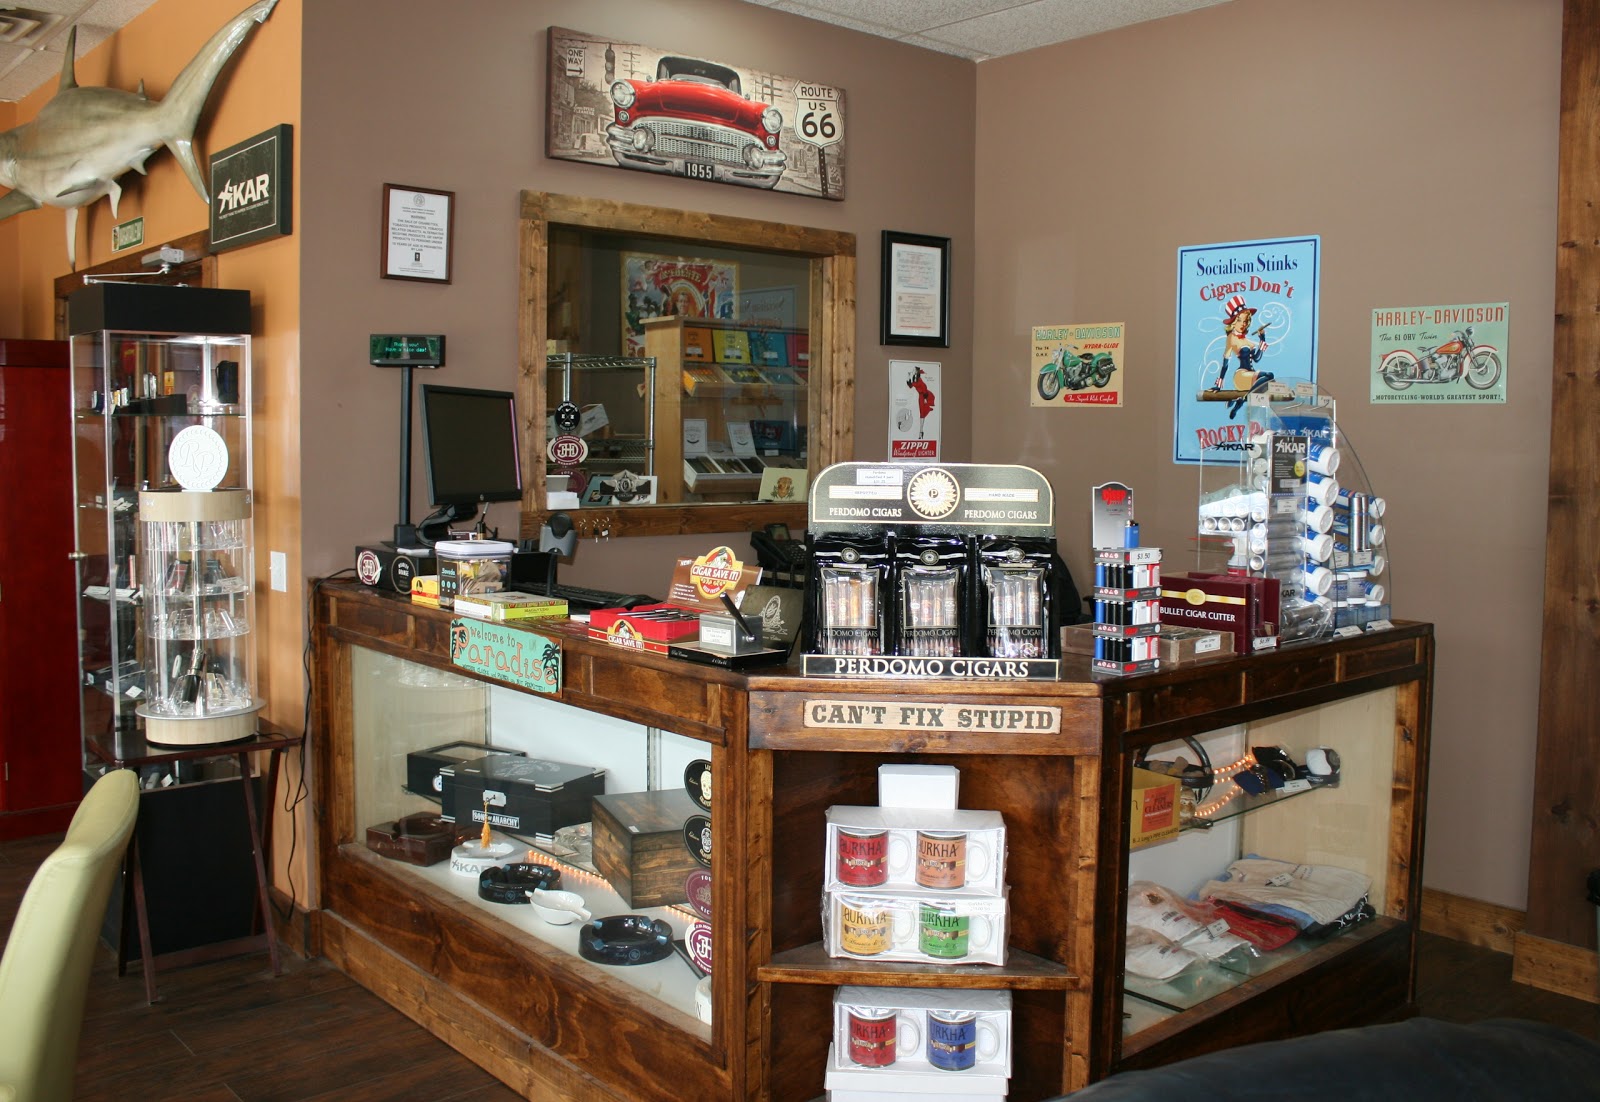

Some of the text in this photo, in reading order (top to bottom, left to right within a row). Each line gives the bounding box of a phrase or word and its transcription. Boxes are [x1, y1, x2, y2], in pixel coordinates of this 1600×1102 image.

[568, 49, 583, 57] ONE
[568, 57, 583, 65] WAY
[800, 86, 833, 99] ROUTE
[808, 101, 827, 112] US
[802, 112, 836, 138] 66
[686, 164, 713, 179] 1955
[1197, 253, 1298, 276] Socialism Stinks
[1200, 275, 1294, 301] Cigars Don't
[1376, 307, 1504, 326] HARLEY-DAVIDSON
[1419, 332, 1437, 340] Twin
[1196, 424, 1246, 449] ROCKY
[900, 441, 929, 450] ZIPPO
[829, 507, 902, 517] PERDOMO CIGARS
[965, 510, 1037, 519] PERDOMO CIGARS
[693, 566, 739, 580] CIGAR SAVE IT!
[1160, 607, 1235, 622] BULLET CIGAR CUTTER
[507, 633, 516, 647] to
[608, 636, 622, 644] CIGAR
[622, 638, 635, 648] SAVE
[453, 626, 557, 685] Paradise
[835, 659, 1029, 677] PERDOMO CIGARS
[812, 705, 1053, 730] CAN'T FIX STUPID
[473, 811, 488, 820] SON
[492, 815, 518, 827] ANARCHY
[840, 839, 882, 855] GURKHA
[851, 1023, 887, 1038] URKHA
[931, 1025, 967, 1041] URKHA
